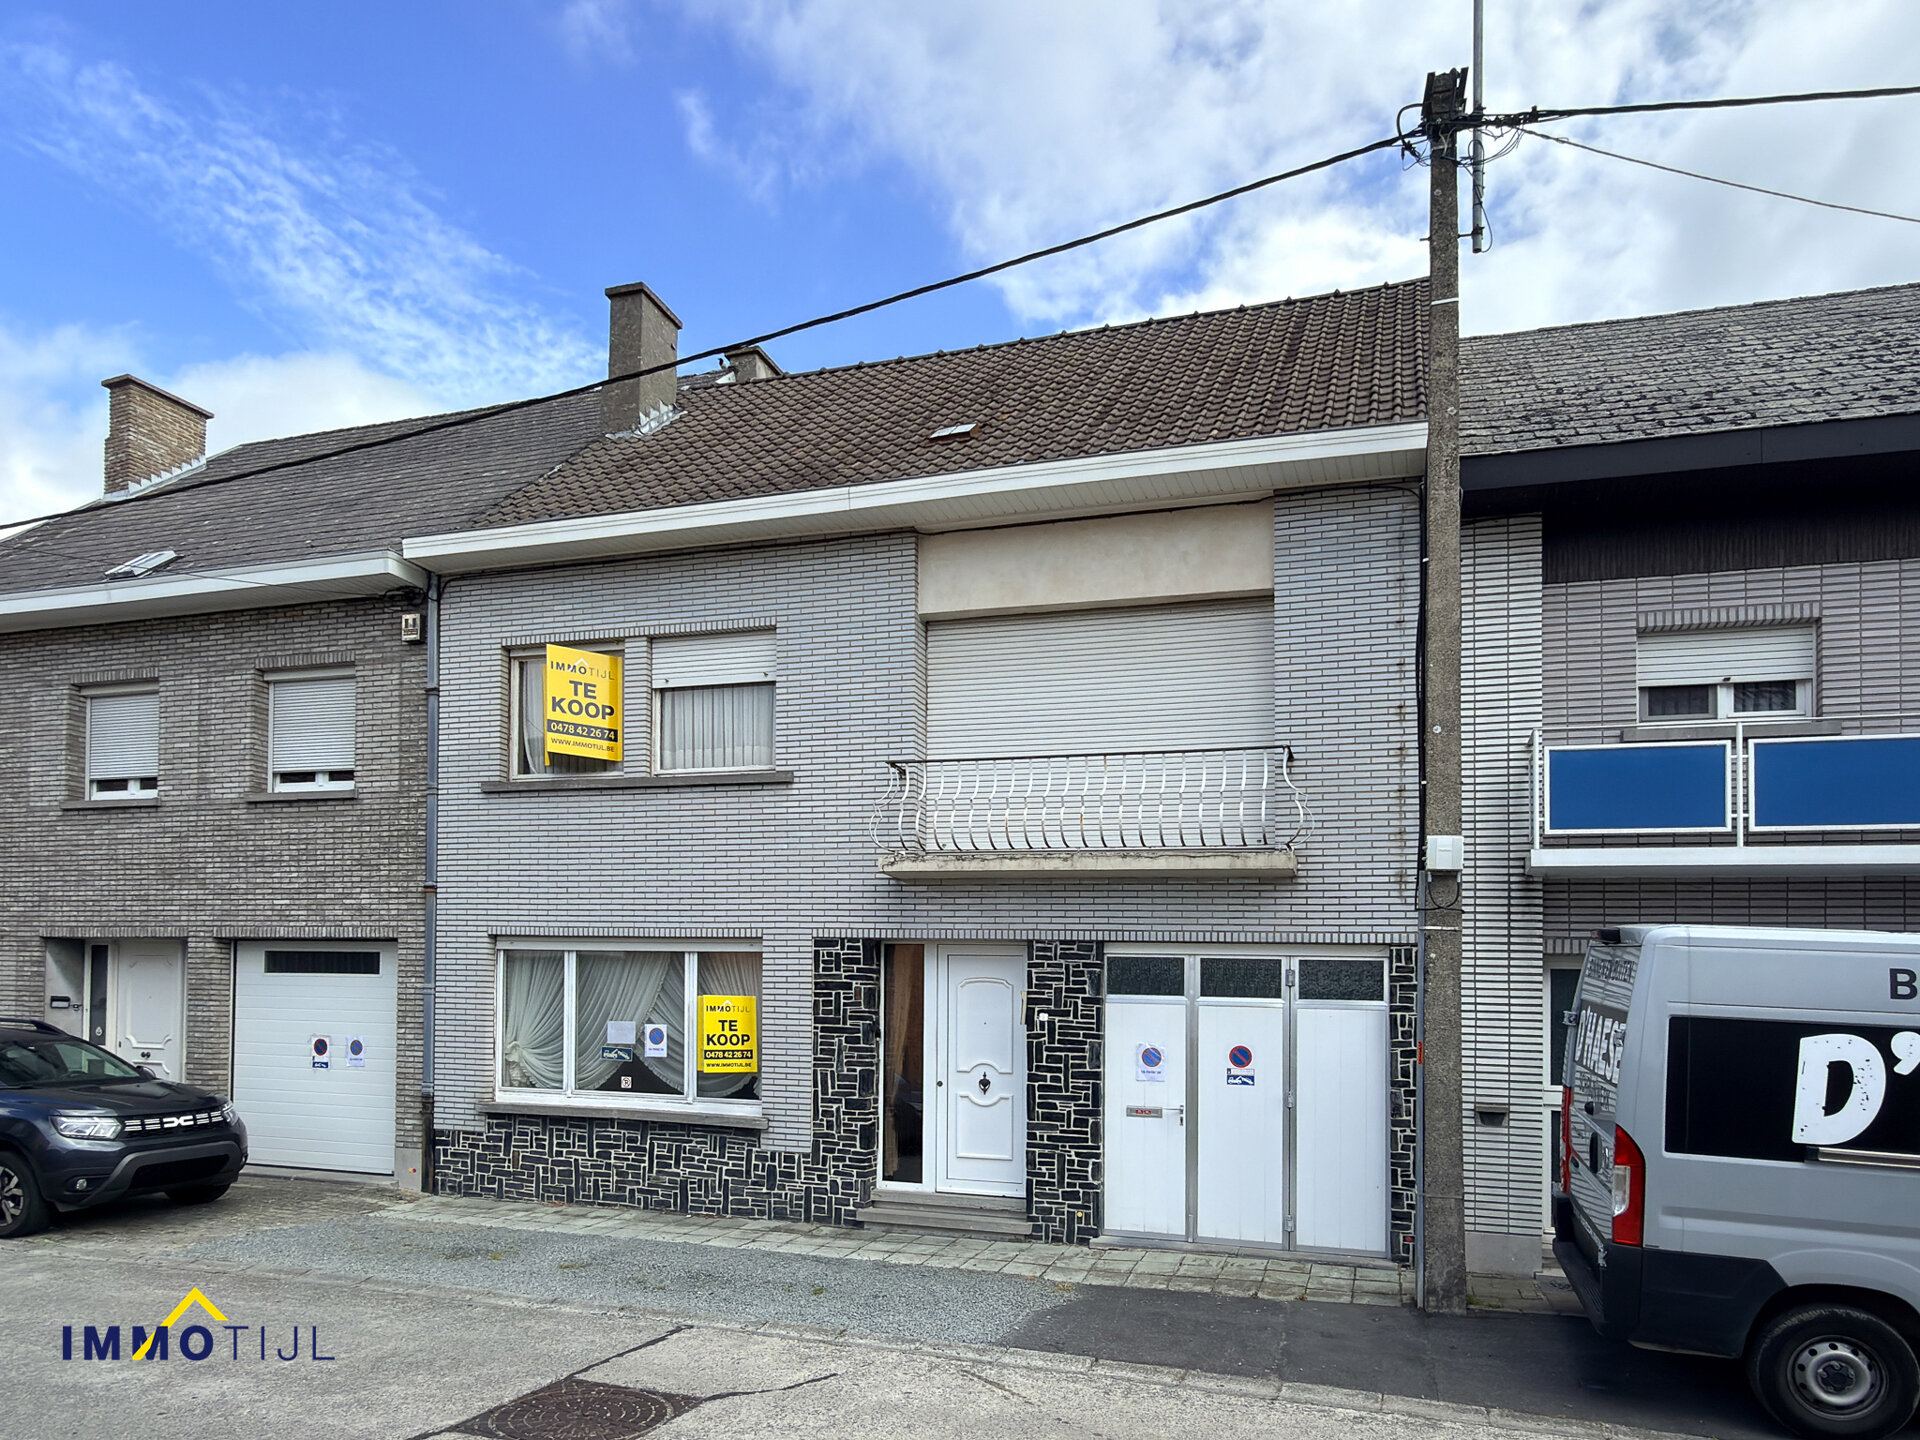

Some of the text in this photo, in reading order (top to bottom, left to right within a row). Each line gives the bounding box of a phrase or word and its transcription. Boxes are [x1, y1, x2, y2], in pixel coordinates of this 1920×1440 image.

[550, 660, 615, 681] IMMOTIJL
[568, 680, 597, 700] TE
[551, 696, 615, 720] KOOP
[550, 722, 615, 740] 0478 42 26 74
[1889, 968, 1918, 1000] B
[706, 1005, 751, 1013] IMMOTIJL
[718, 1019, 738, 1032] TE
[706, 1033, 751, 1046] KOOP
